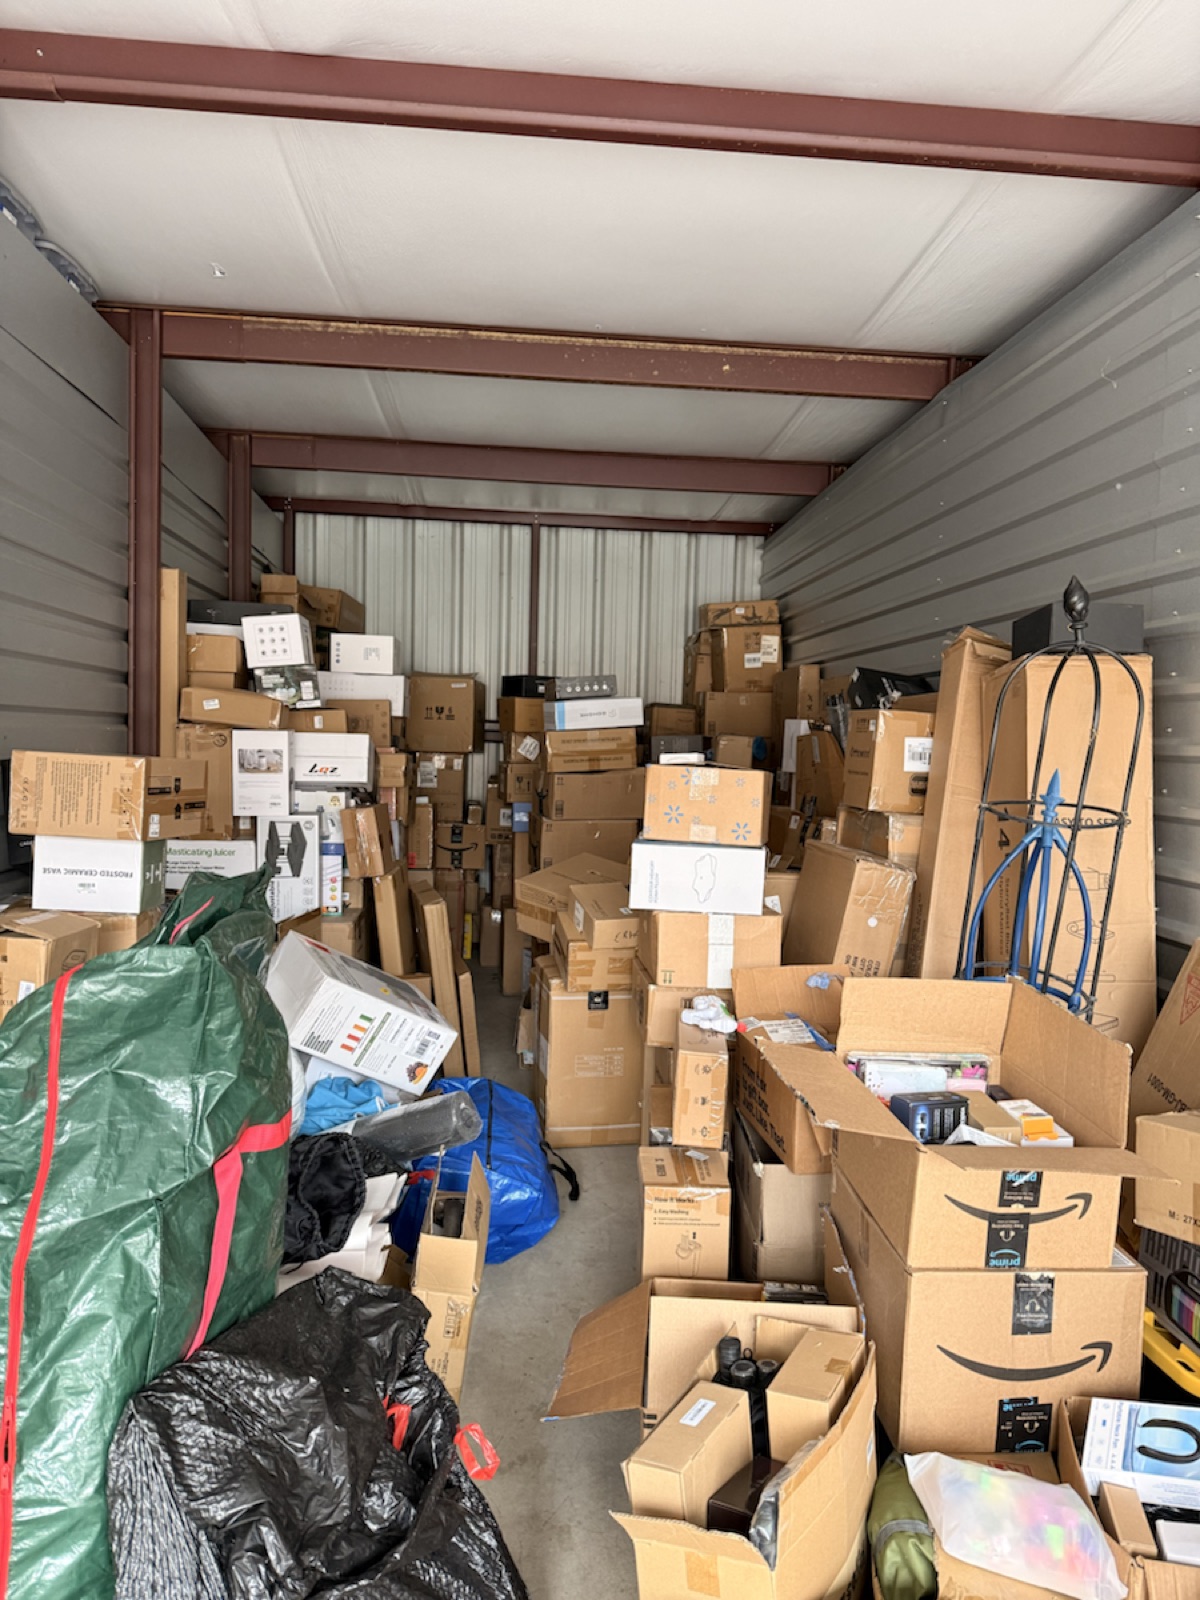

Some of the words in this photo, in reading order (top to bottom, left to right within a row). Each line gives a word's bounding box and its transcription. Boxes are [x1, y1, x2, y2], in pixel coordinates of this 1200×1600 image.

[42, 866, 62, 875] VASE
[63, 867, 98, 877] CERAMIC
[99, 869, 133, 879] FROSTED
[989, 1256, 1020, 1268] prime
